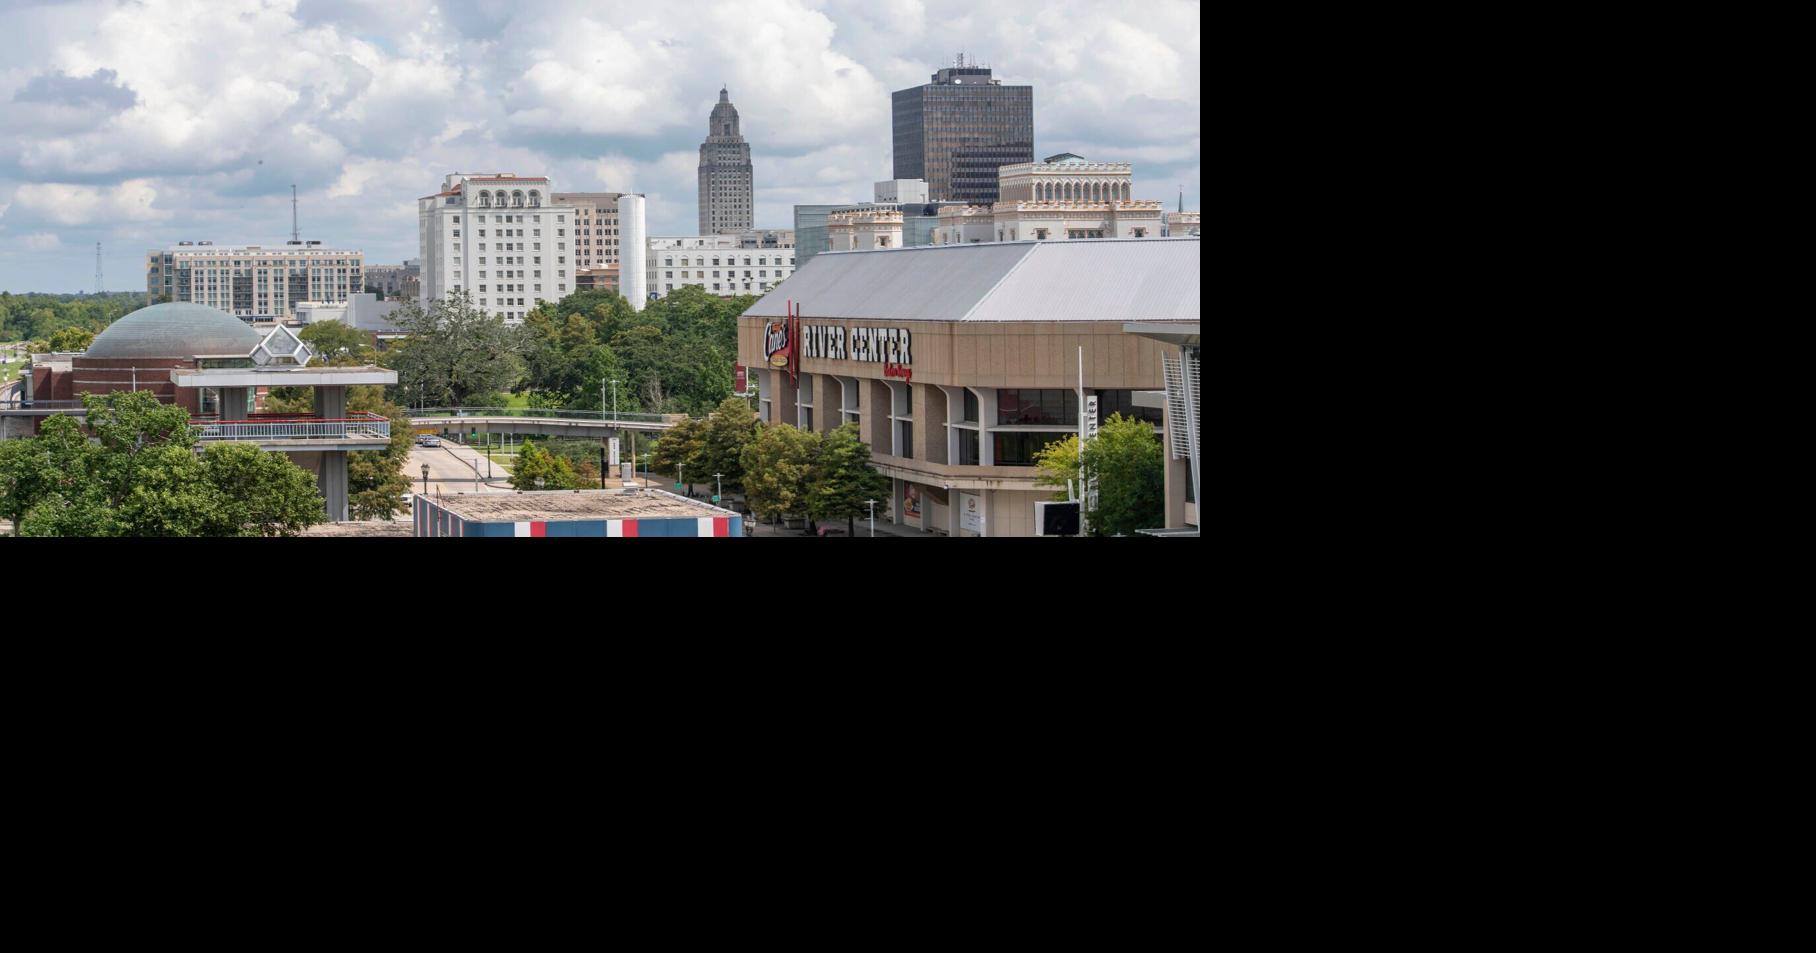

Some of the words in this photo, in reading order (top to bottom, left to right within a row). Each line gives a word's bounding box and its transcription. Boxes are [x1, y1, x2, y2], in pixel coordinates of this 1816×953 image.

[803, 325, 847, 359] RIVER
[850, 327, 912, 364] CENTER
[1089, 401, 1097, 439] ENTER
